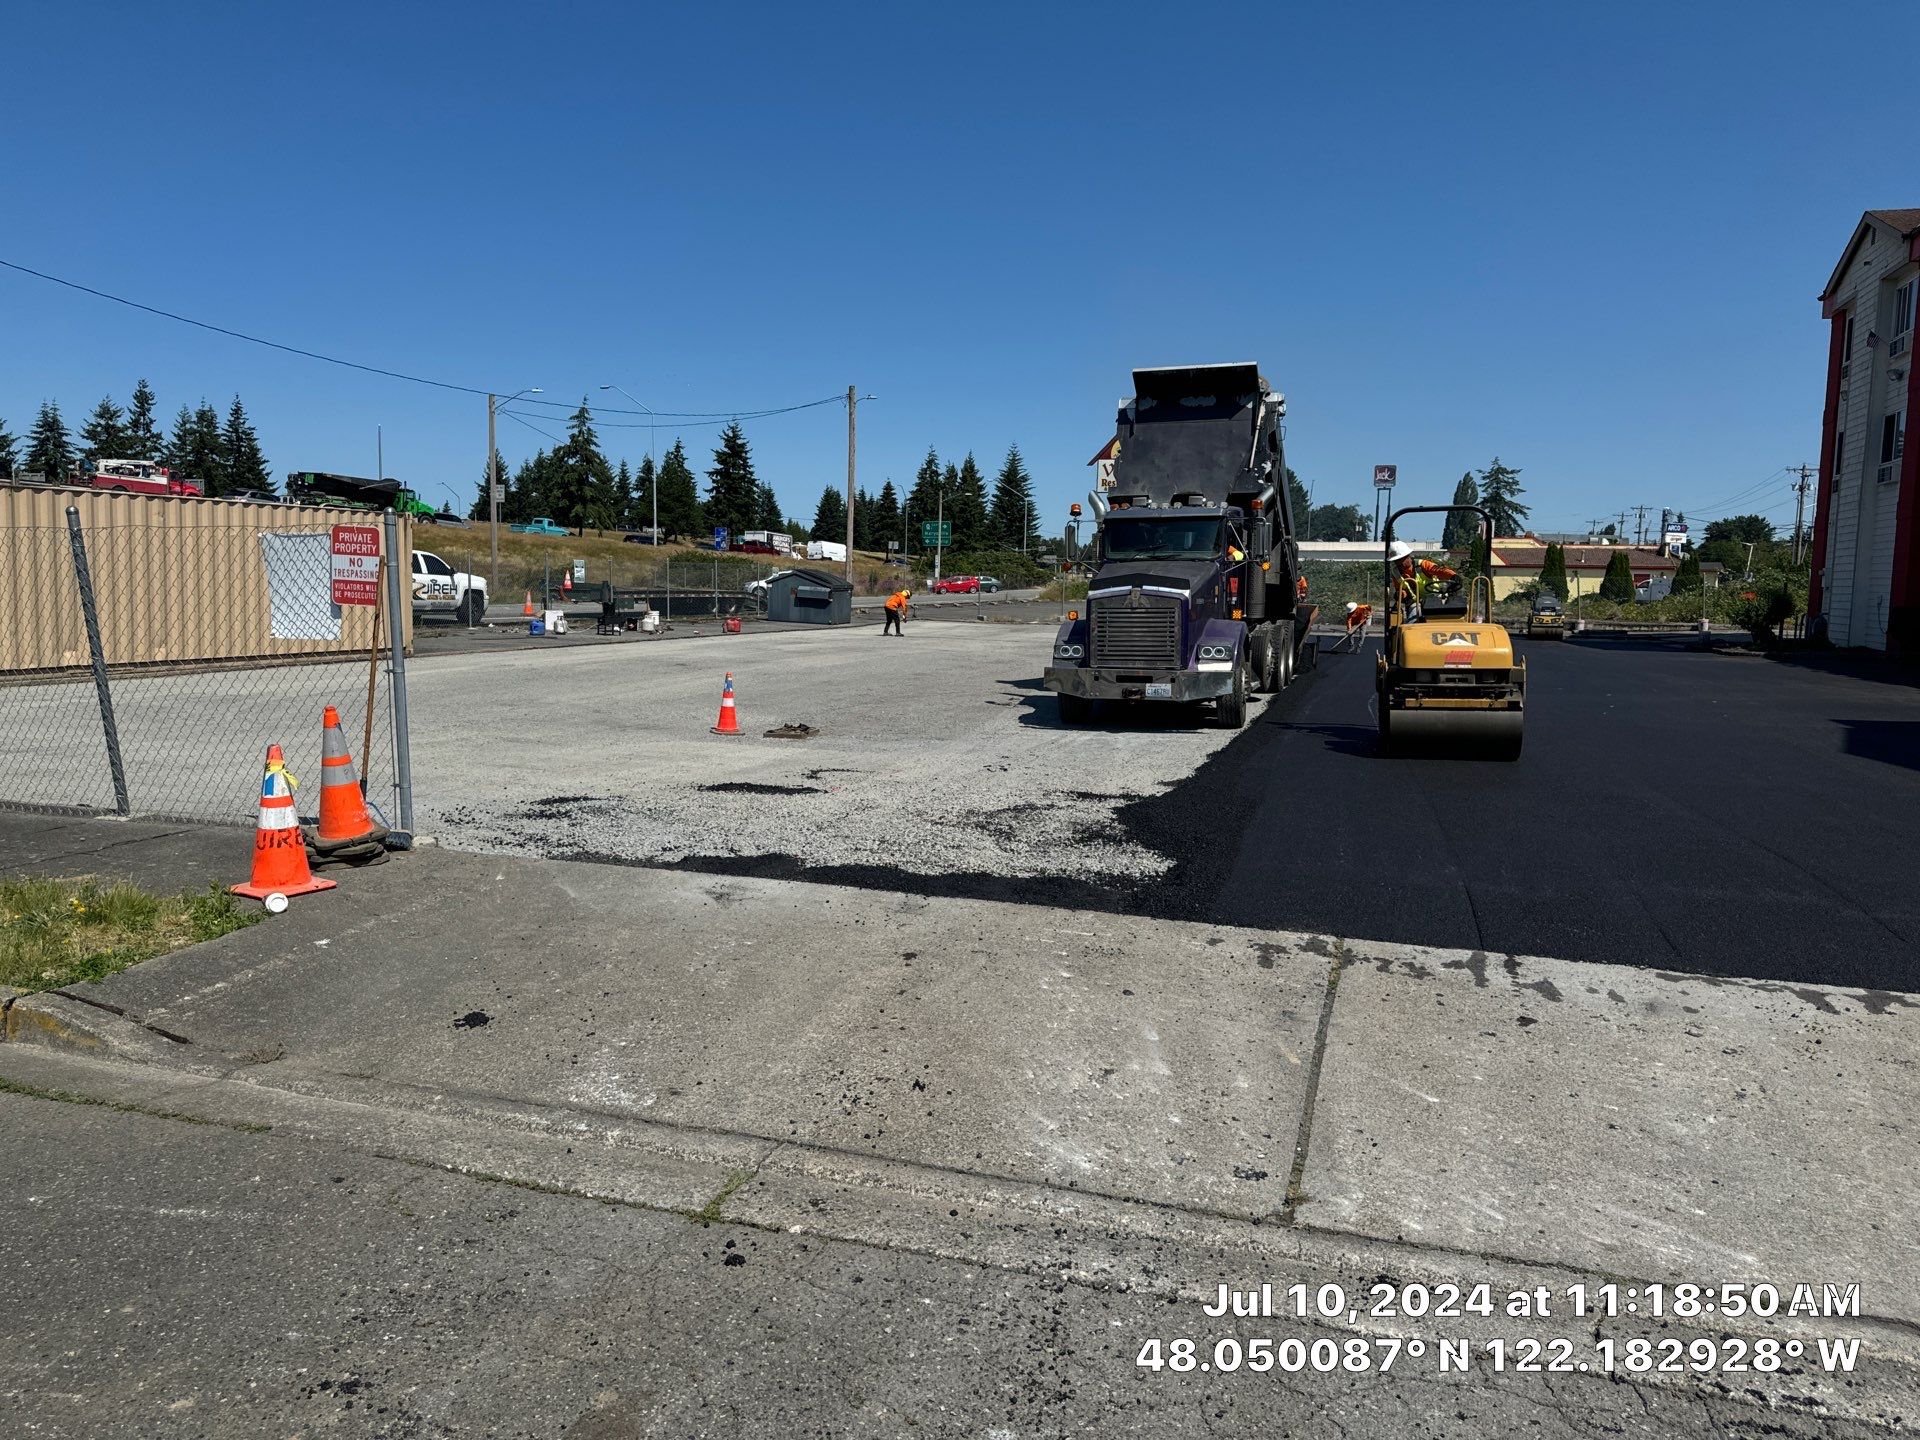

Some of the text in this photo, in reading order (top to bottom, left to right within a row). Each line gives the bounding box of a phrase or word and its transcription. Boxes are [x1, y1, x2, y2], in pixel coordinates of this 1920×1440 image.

[339, 532, 373, 544] PRIVATE
[334, 542, 377, 554] PROPERTY
[349, 557, 363, 568] NO
[333, 568, 379, 580] TRESPASSING
[335, 582, 364, 591] VIOLATORS
[422, 583, 458, 595] JIREH
[1431, 632, 1481, 646] CAT
